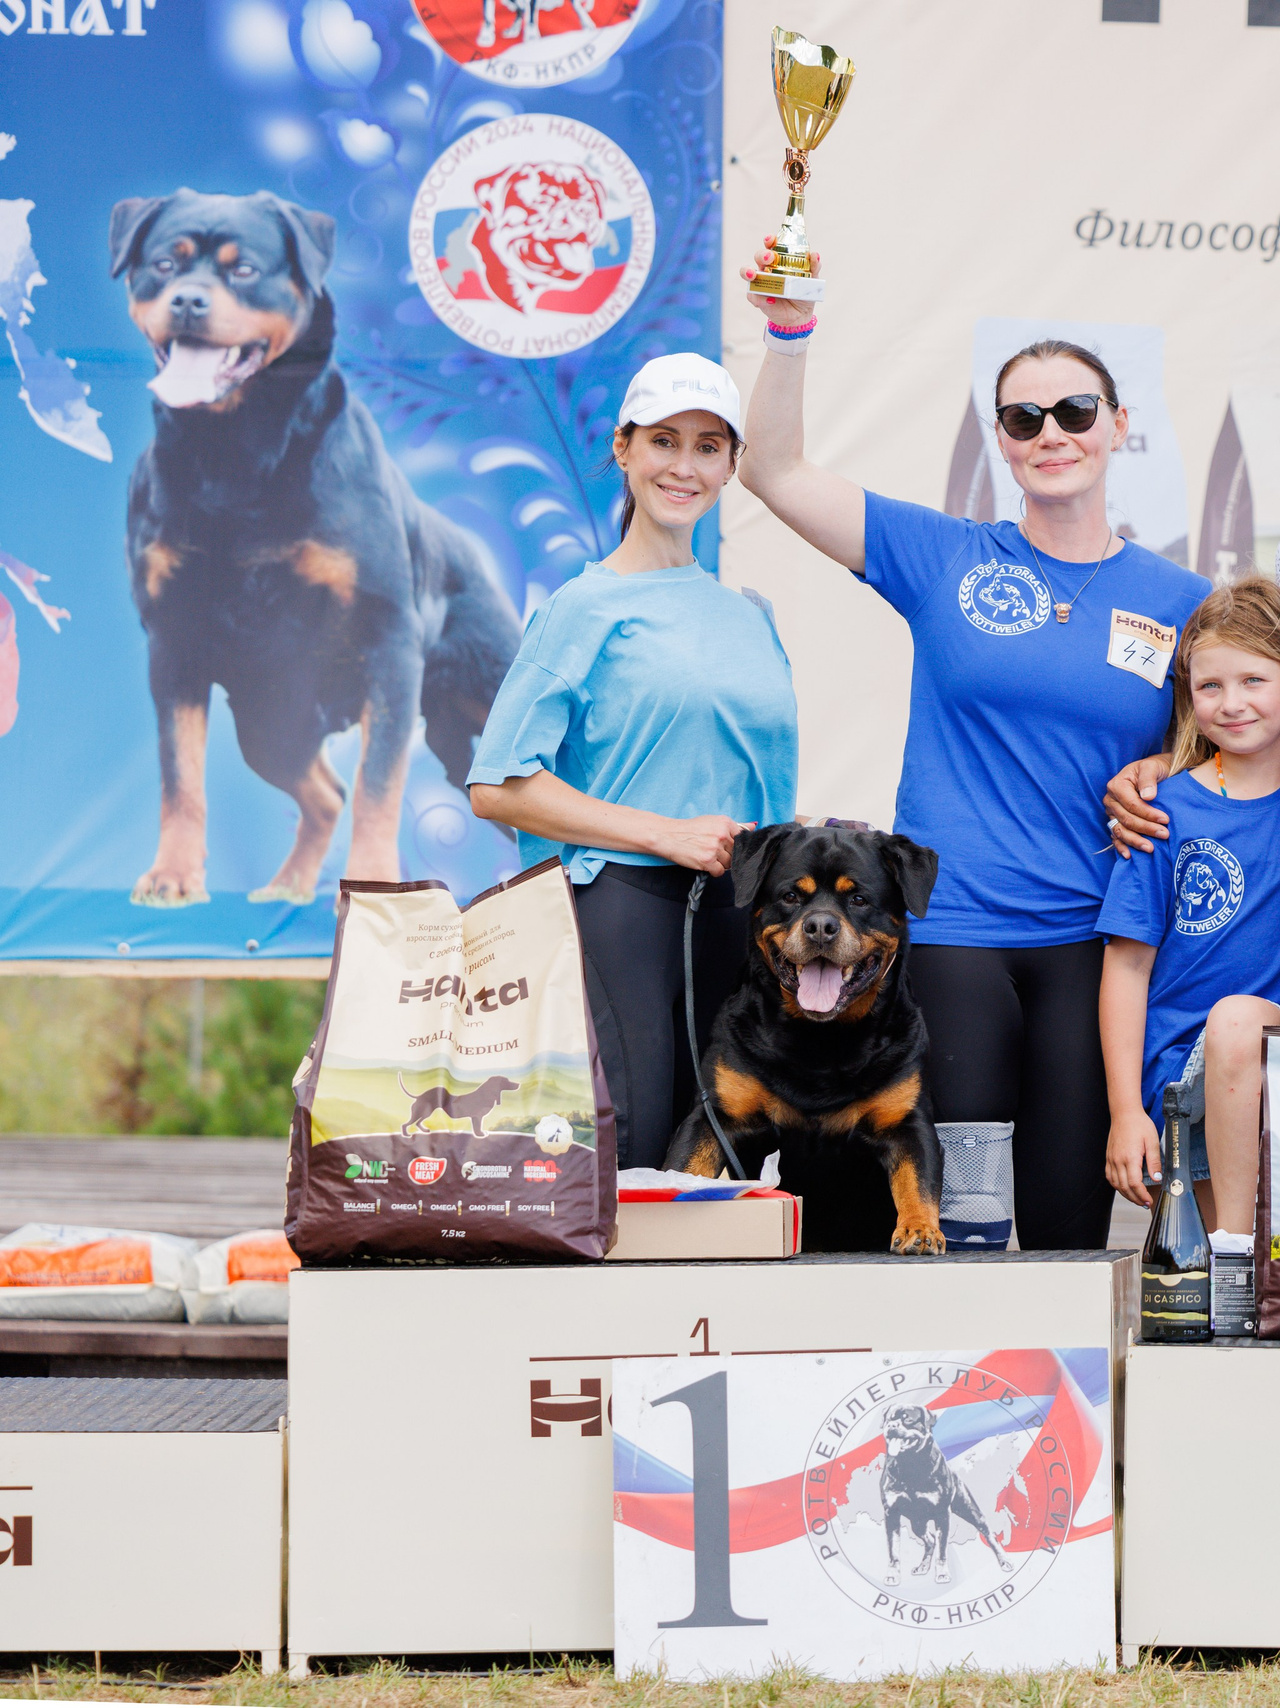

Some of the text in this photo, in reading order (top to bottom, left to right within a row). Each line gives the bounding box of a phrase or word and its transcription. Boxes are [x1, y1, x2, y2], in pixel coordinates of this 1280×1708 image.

[482, 117, 534, 146] 2024
[415, 138, 481, 221] РОССИИ
[548, 116, 652, 271] НАЦИОНАЛЬНЫЙ
[522, 274, 640, 354] ЧЕМПИОНАТ
[672, 379, 720, 399] FILA
[1008, 566, 1041, 588] TORRA
[969, 612, 1035, 634] ROTTWEILER
[1116, 615, 1173, 642] Hanta
[1123, 640, 1156, 665] 47
[1198, 841, 1229, 863] TORRA
[418, 923, 440, 932] Корм
[1176, 906, 1234, 933] OTTWEILER
[406, 935, 443, 943] взрослых
[436, 943, 464, 958] говяд
[468, 952, 496, 975] рисом
[398, 974, 529, 1016] Hanta
[415, 1161, 439, 1171] FRESH
[415, 1171, 436, 1180] MEAT
[391, 1203, 418, 1211] OMEGA
[517, 1204, 531, 1212] SOY
[1144, 1294, 1202, 1304] DI CASPICO
[529, 1377, 612, 1438] H
[807, 1366, 1070, 1562] РОТВЕЙЛЕР КЛУБ РОССИИ
[650, 1370, 769, 1630] 1
[872, 1582, 1016, 1625] РКФ-НКПР
